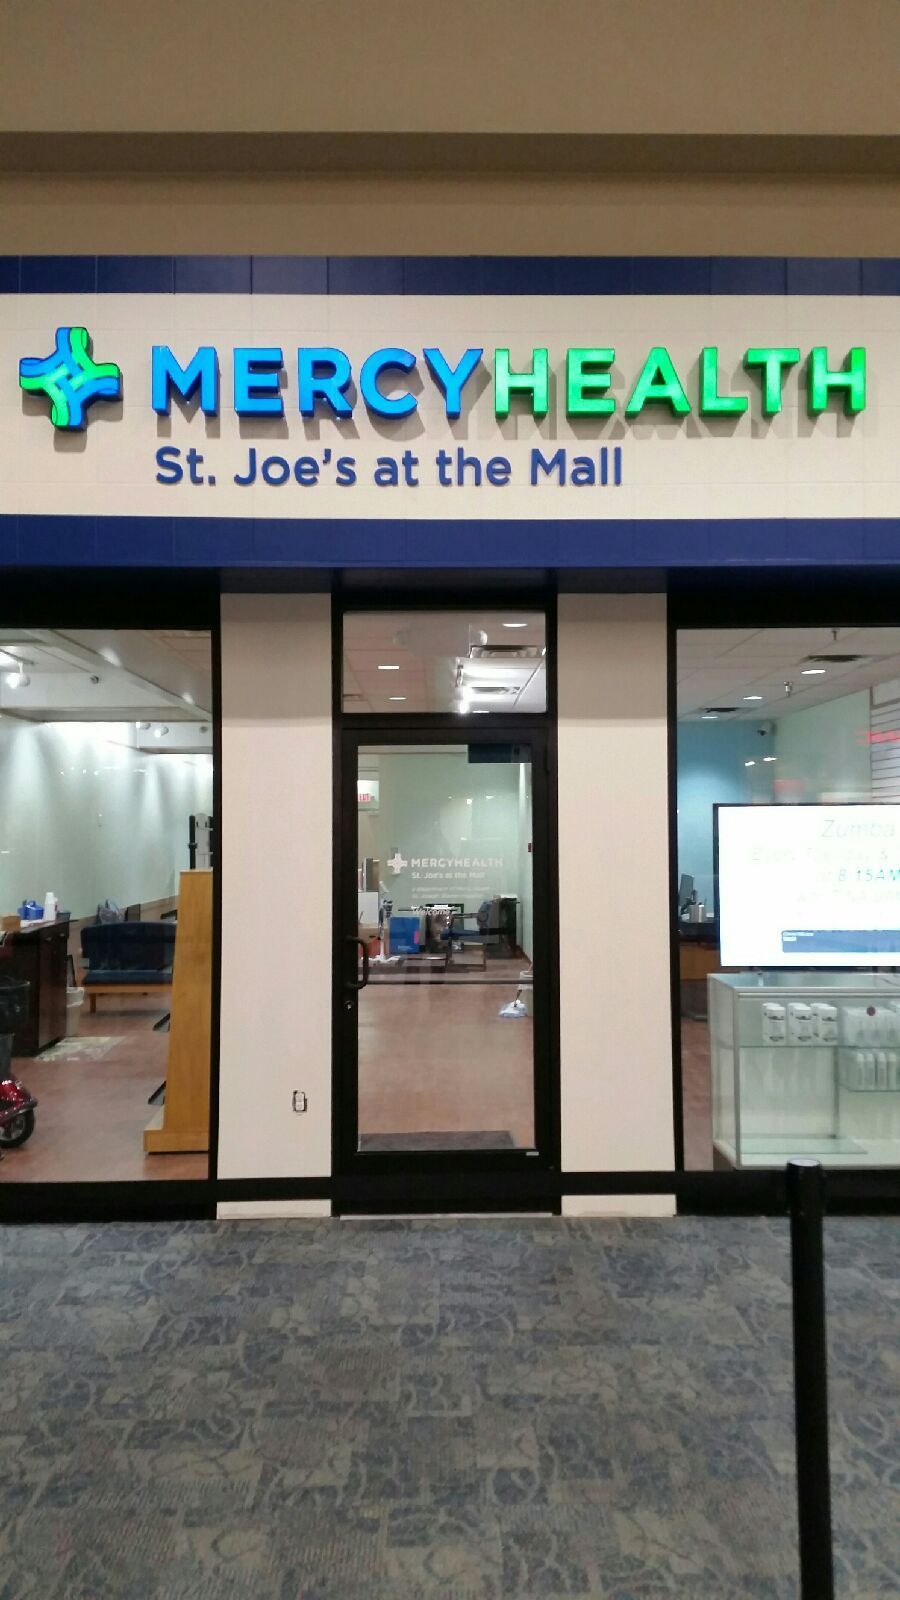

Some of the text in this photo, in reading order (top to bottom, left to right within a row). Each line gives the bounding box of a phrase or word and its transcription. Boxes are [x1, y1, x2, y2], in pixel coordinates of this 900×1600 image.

[155, 446, 622, 486] St. Joe's at the Mall
[411, 858, 504, 868] MERCYHEALTH
